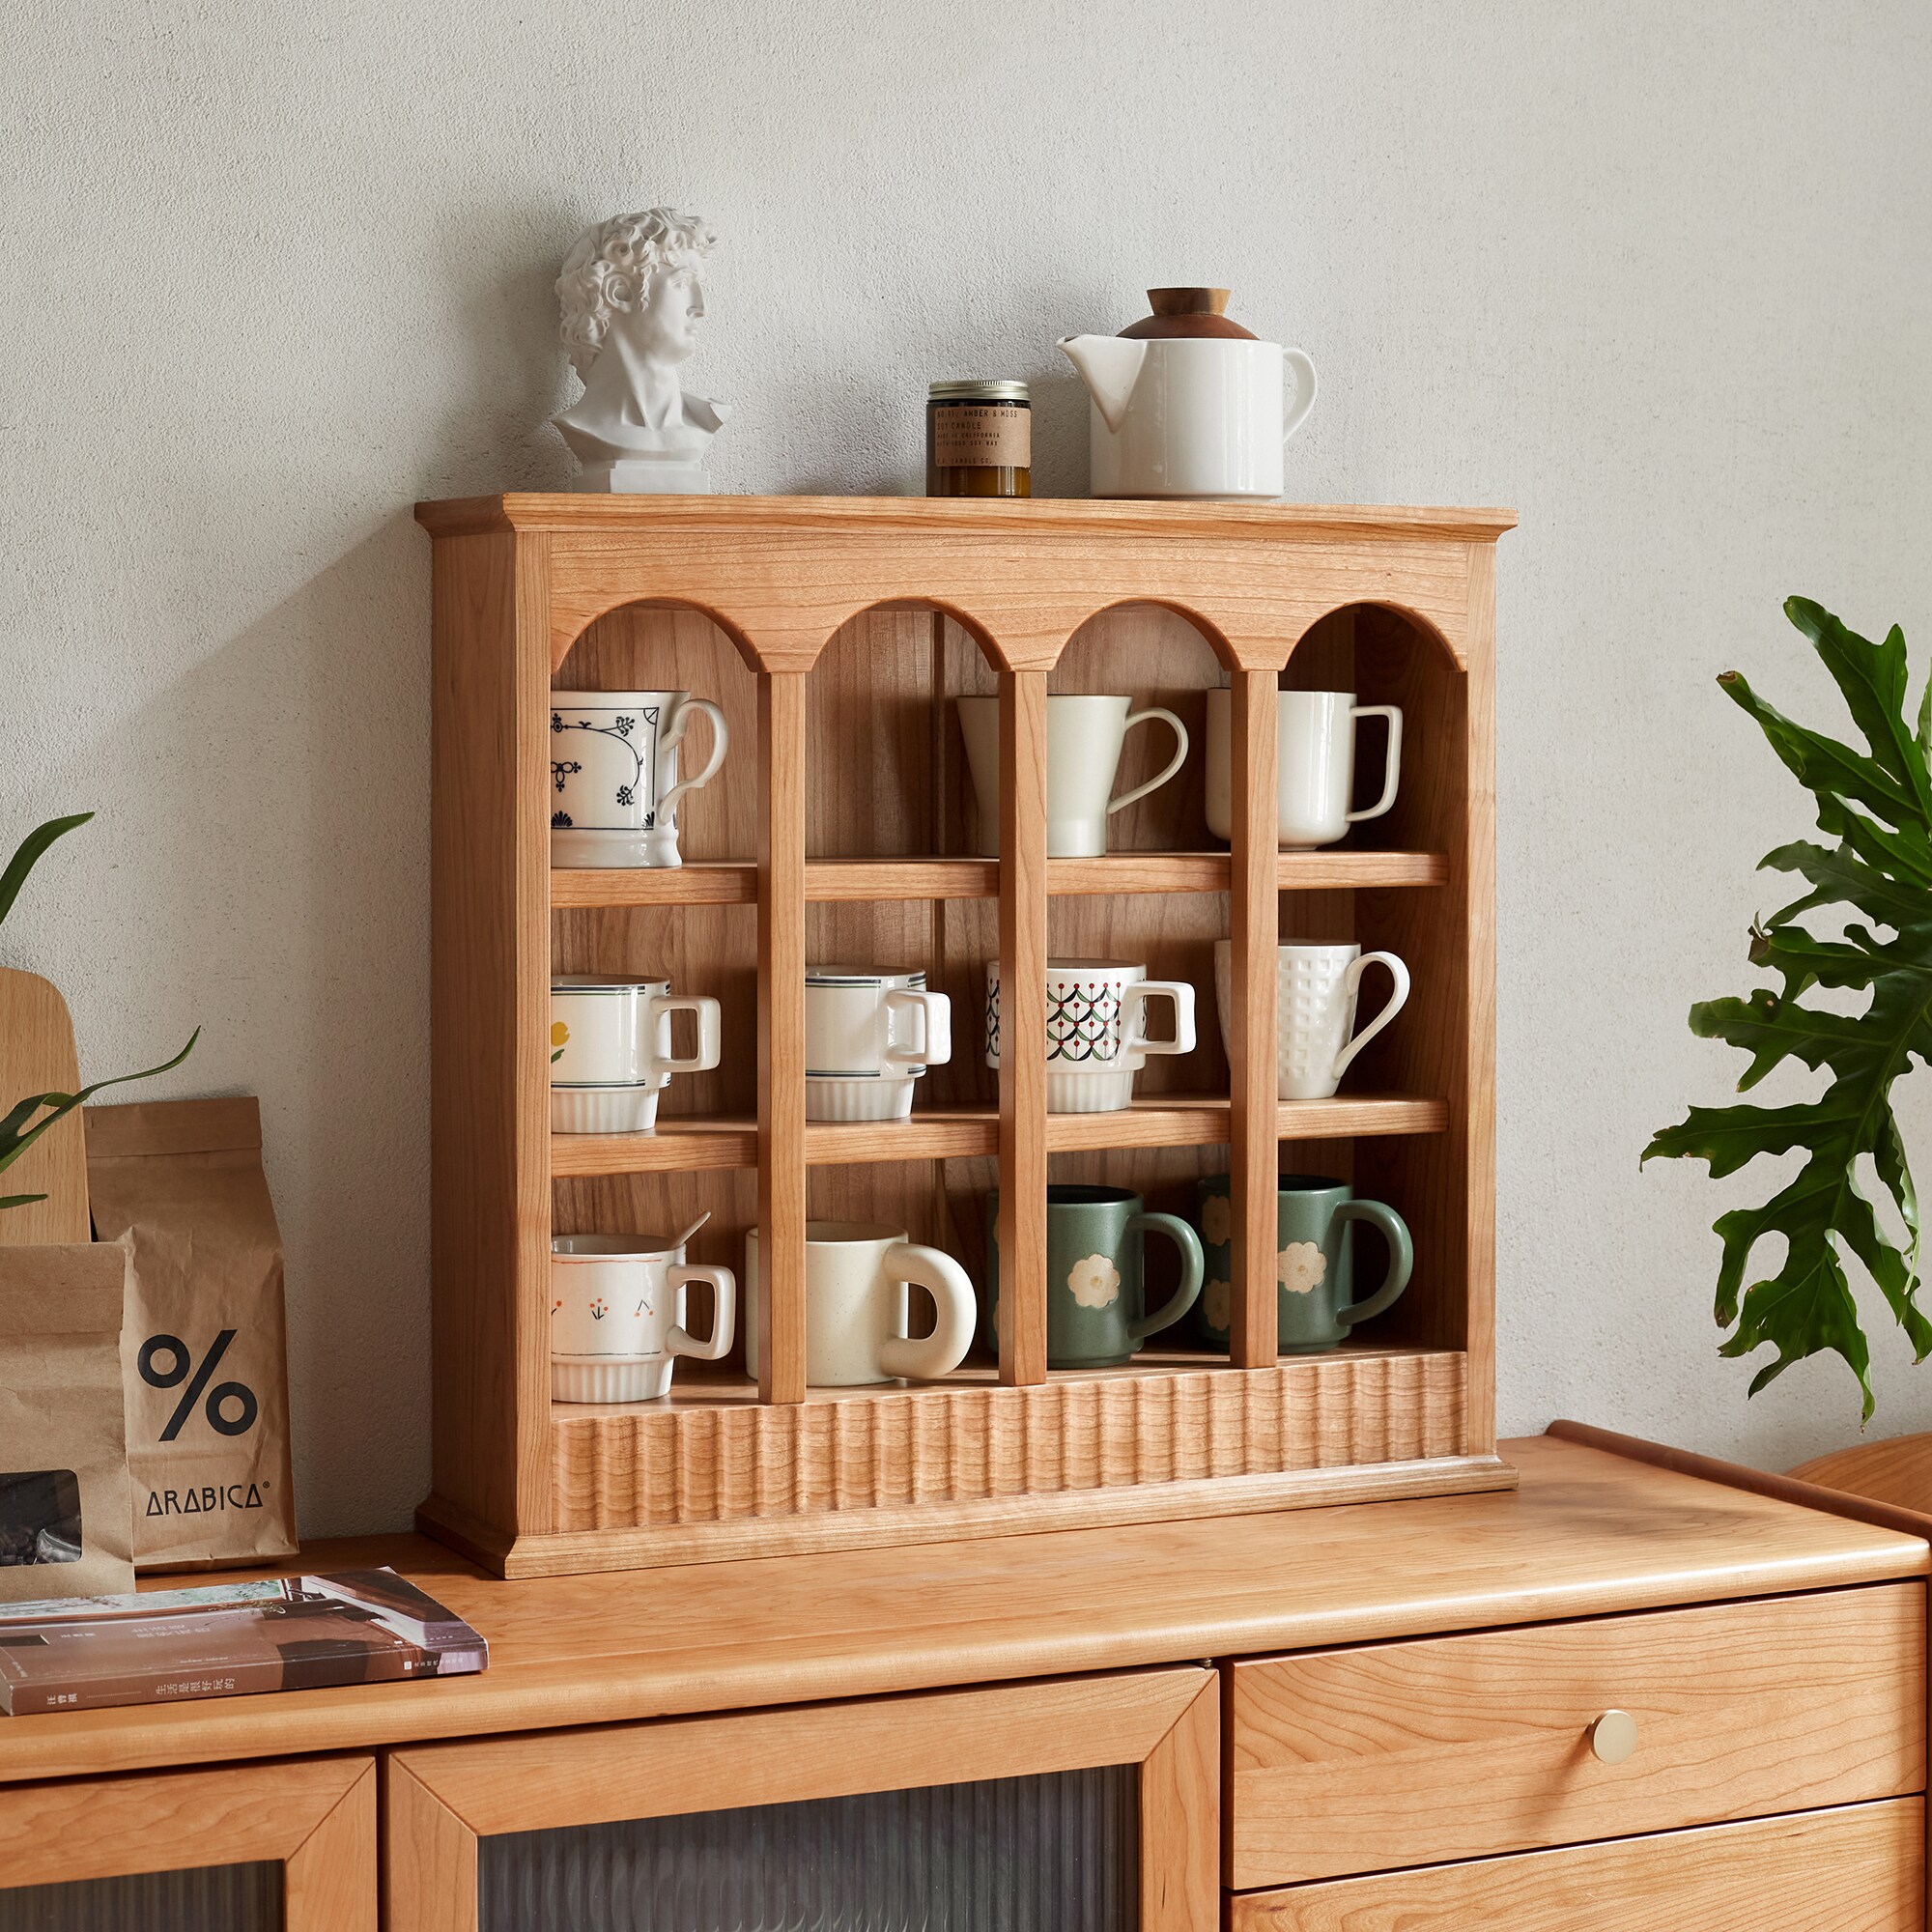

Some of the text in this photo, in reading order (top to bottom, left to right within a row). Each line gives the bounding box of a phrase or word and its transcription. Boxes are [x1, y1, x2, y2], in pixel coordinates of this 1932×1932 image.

[156, 1678, 235, 1695] 生活是很好玩的
